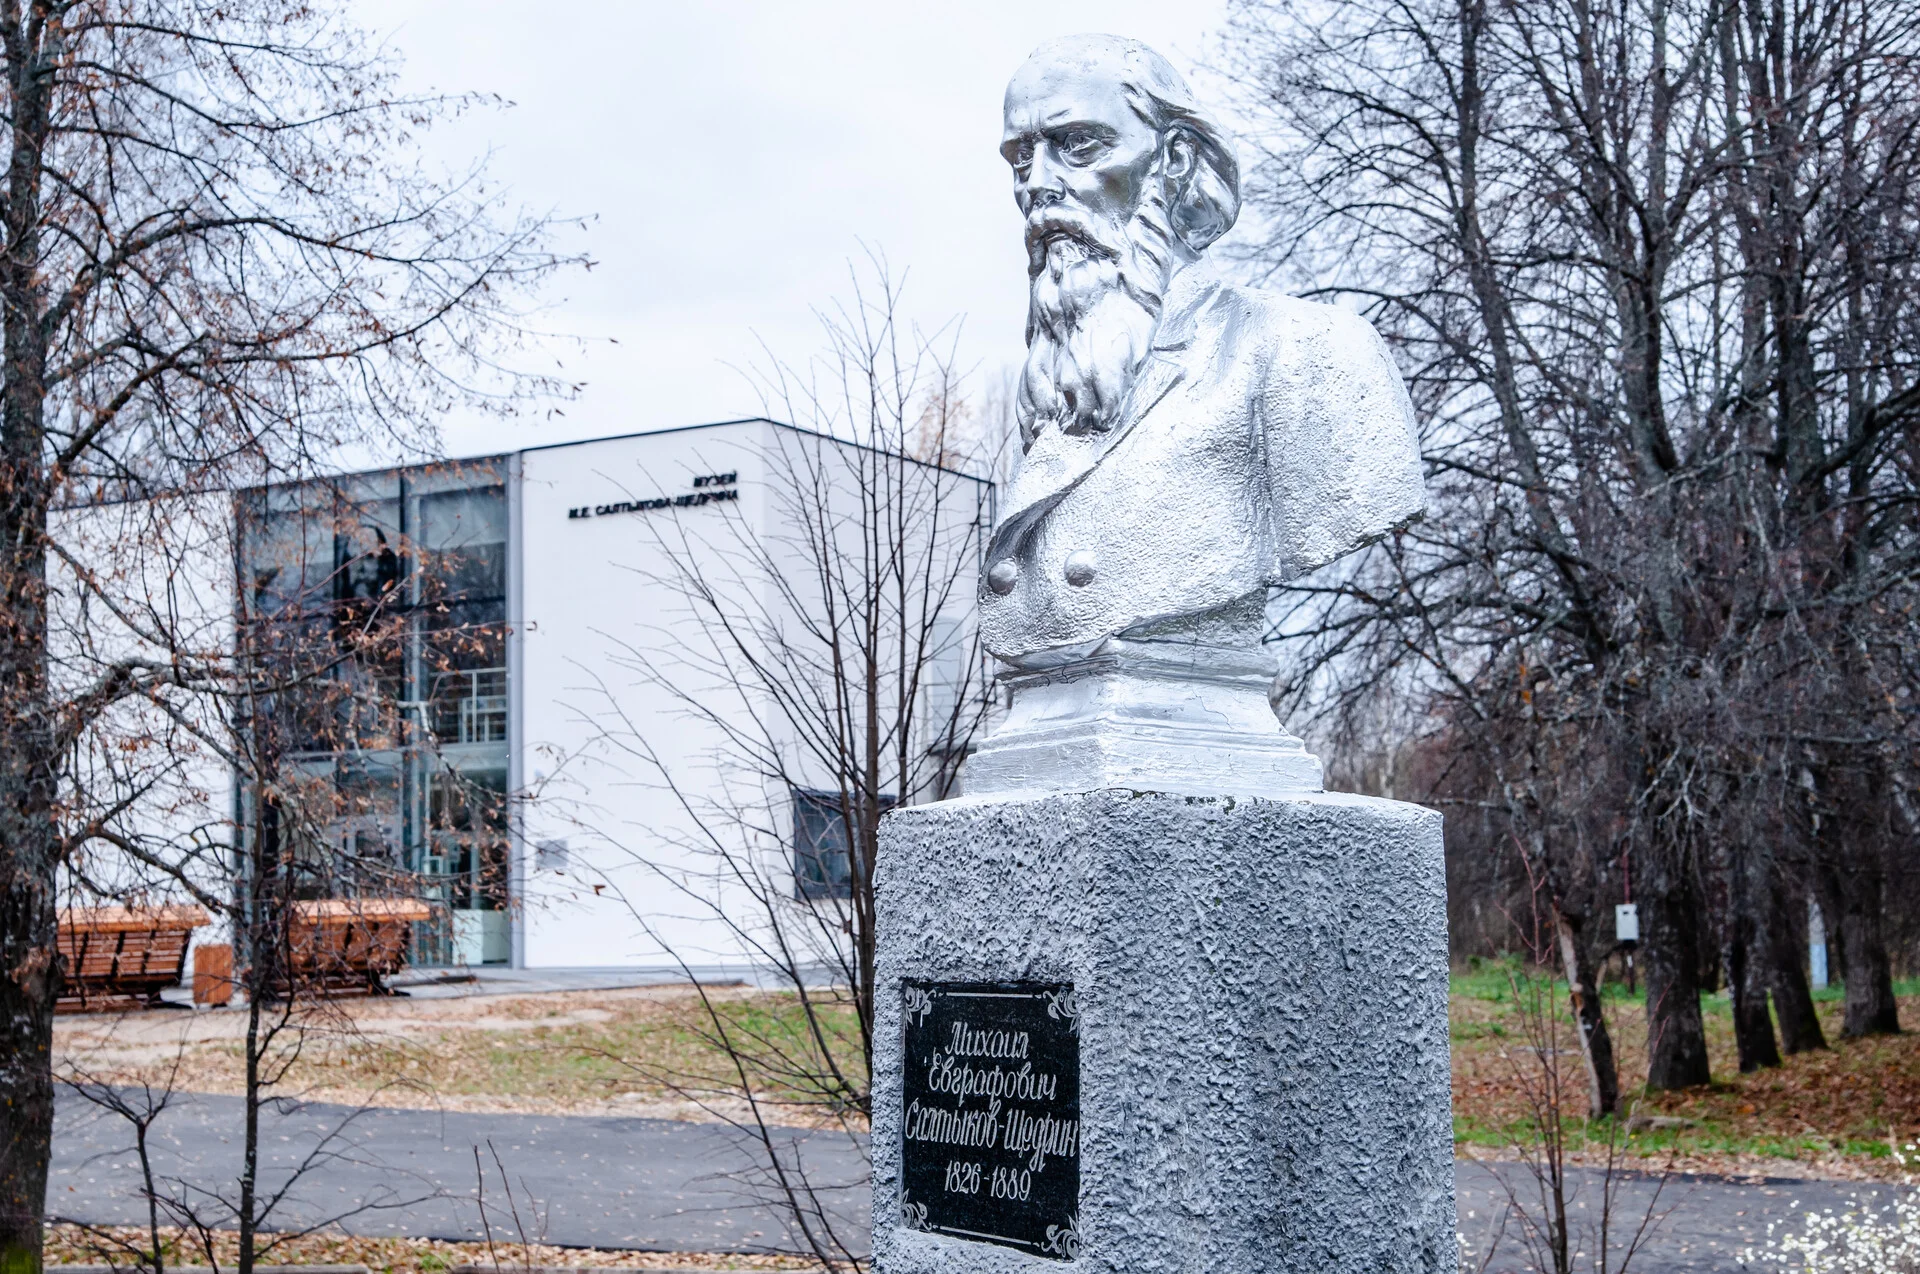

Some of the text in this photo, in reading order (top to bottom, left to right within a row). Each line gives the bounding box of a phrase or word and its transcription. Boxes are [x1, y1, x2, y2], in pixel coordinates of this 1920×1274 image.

[945, 1021, 1029, 1060] Михаил
[929, 1046, 1057, 1109] Евграфович
[904, 1097, 1078, 1172] Салтыков-Щедрин
